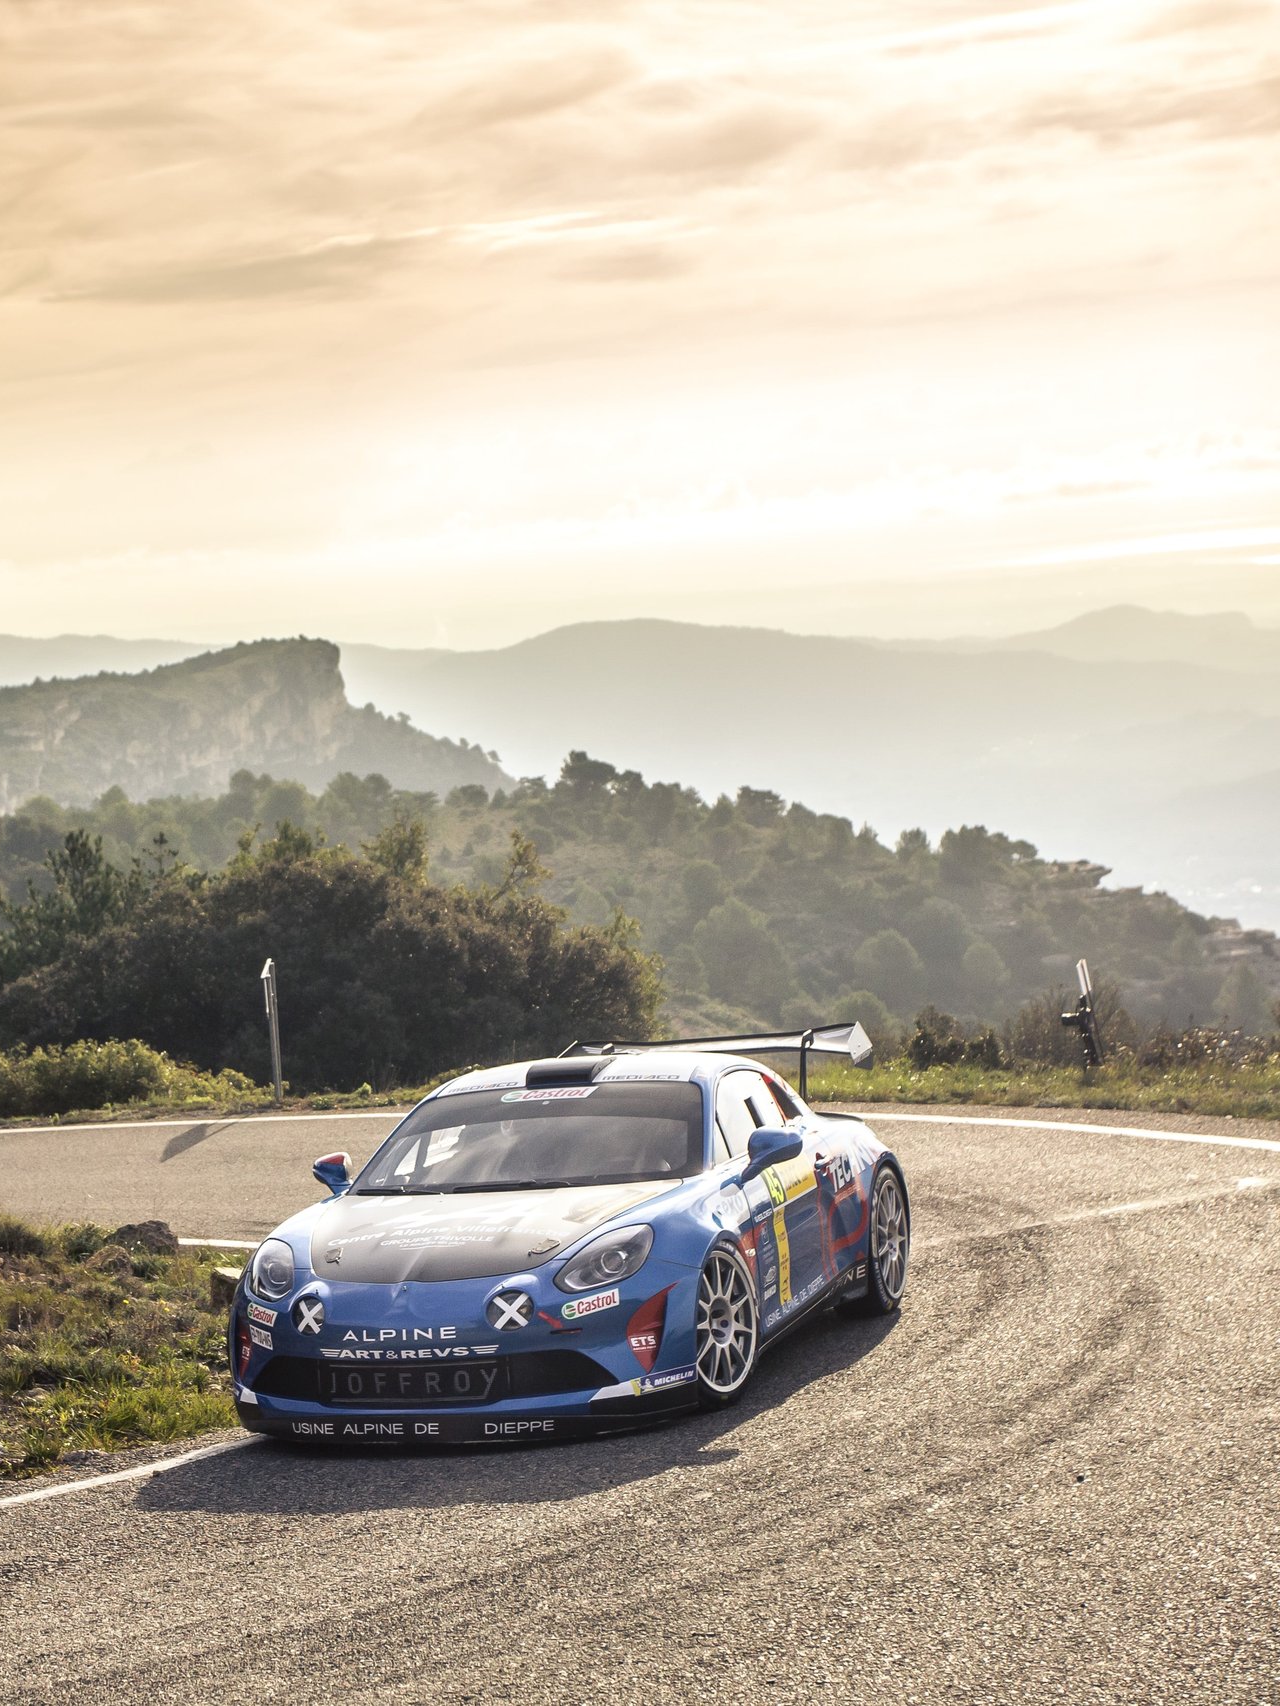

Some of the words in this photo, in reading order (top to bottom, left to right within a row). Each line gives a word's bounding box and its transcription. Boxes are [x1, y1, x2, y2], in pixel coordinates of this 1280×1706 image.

[522, 1086, 589, 1101] Castrol
[328, 1231, 386, 1246] Centre
[391, 1225, 449, 1237] Alpine
[380, 1235, 432, 1246] GROUPE
[577, 1291, 617, 1315] Castrol
[252, 1306, 275, 1325] Castrol
[342, 1326, 457, 1342] ALPINE
[630, 1335, 656, 1347] ETS
[654, 1370, 694, 1386] MICHELIN
[292, 1422, 335, 1435] USINE
[343, 1422, 404, 1435] ALPINE
[414, 1422, 440, 1435] DE
[484, 1419, 555, 1435] DIEPPE
